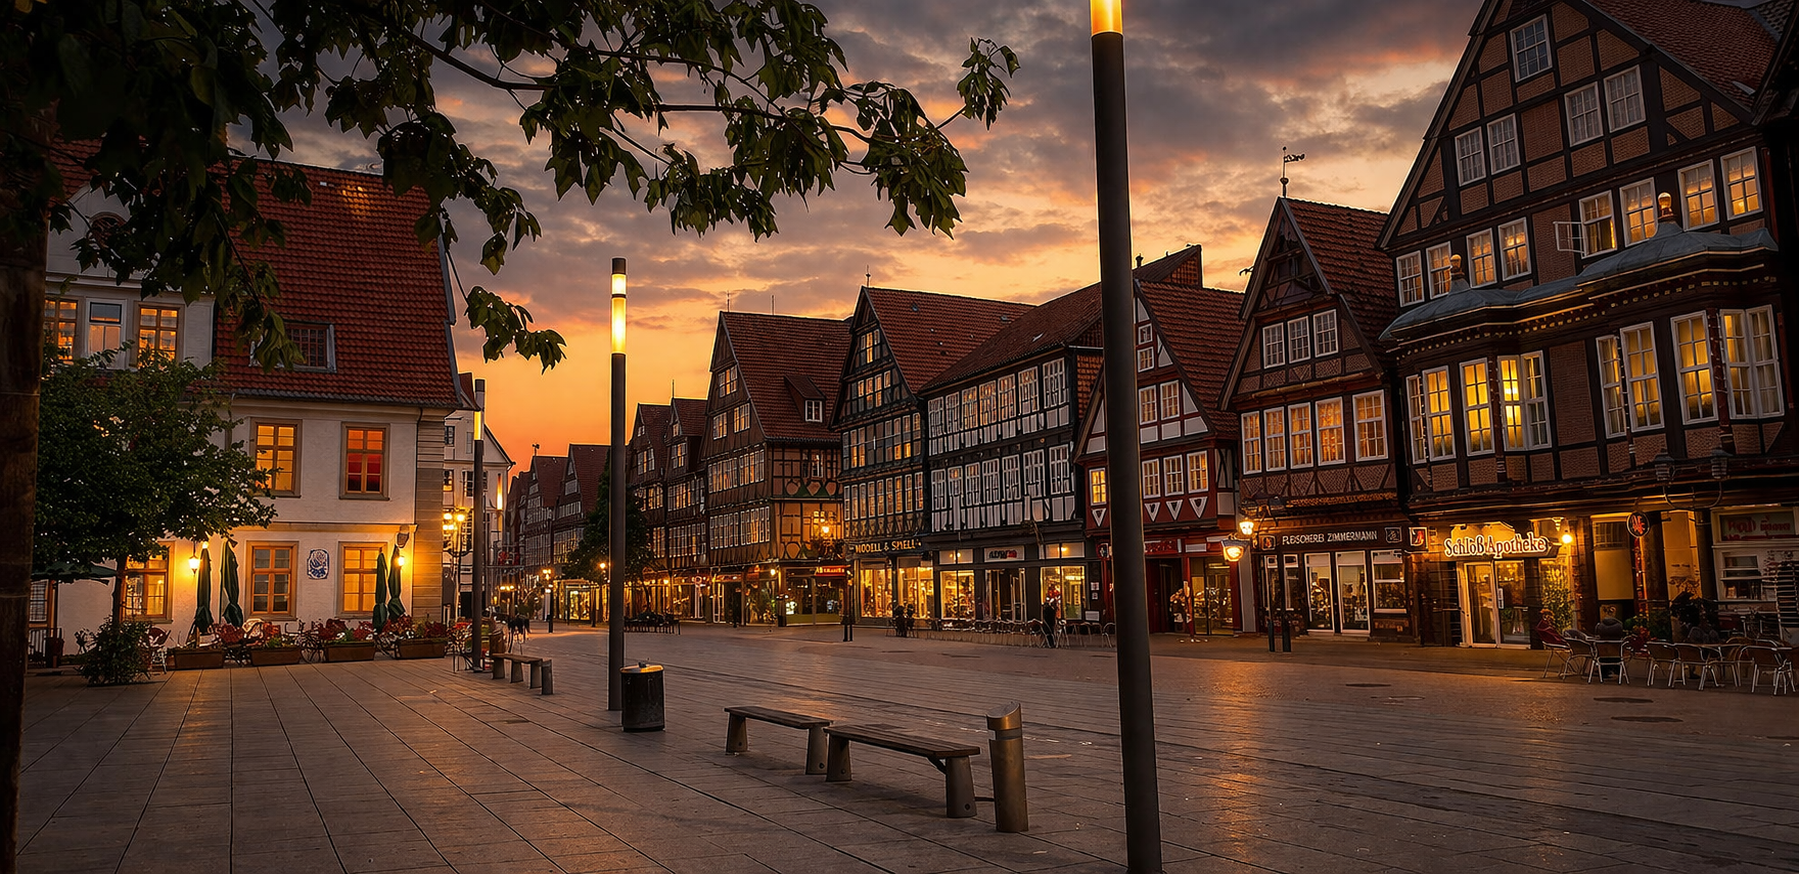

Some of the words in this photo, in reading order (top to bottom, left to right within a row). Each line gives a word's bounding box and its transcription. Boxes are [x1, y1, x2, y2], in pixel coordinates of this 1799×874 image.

[1327, 530, 1378, 542] ZIMMERMANN
[1444, 534, 1485, 557] Schloß
[1485, 531, 1548, 559] Apotheke
